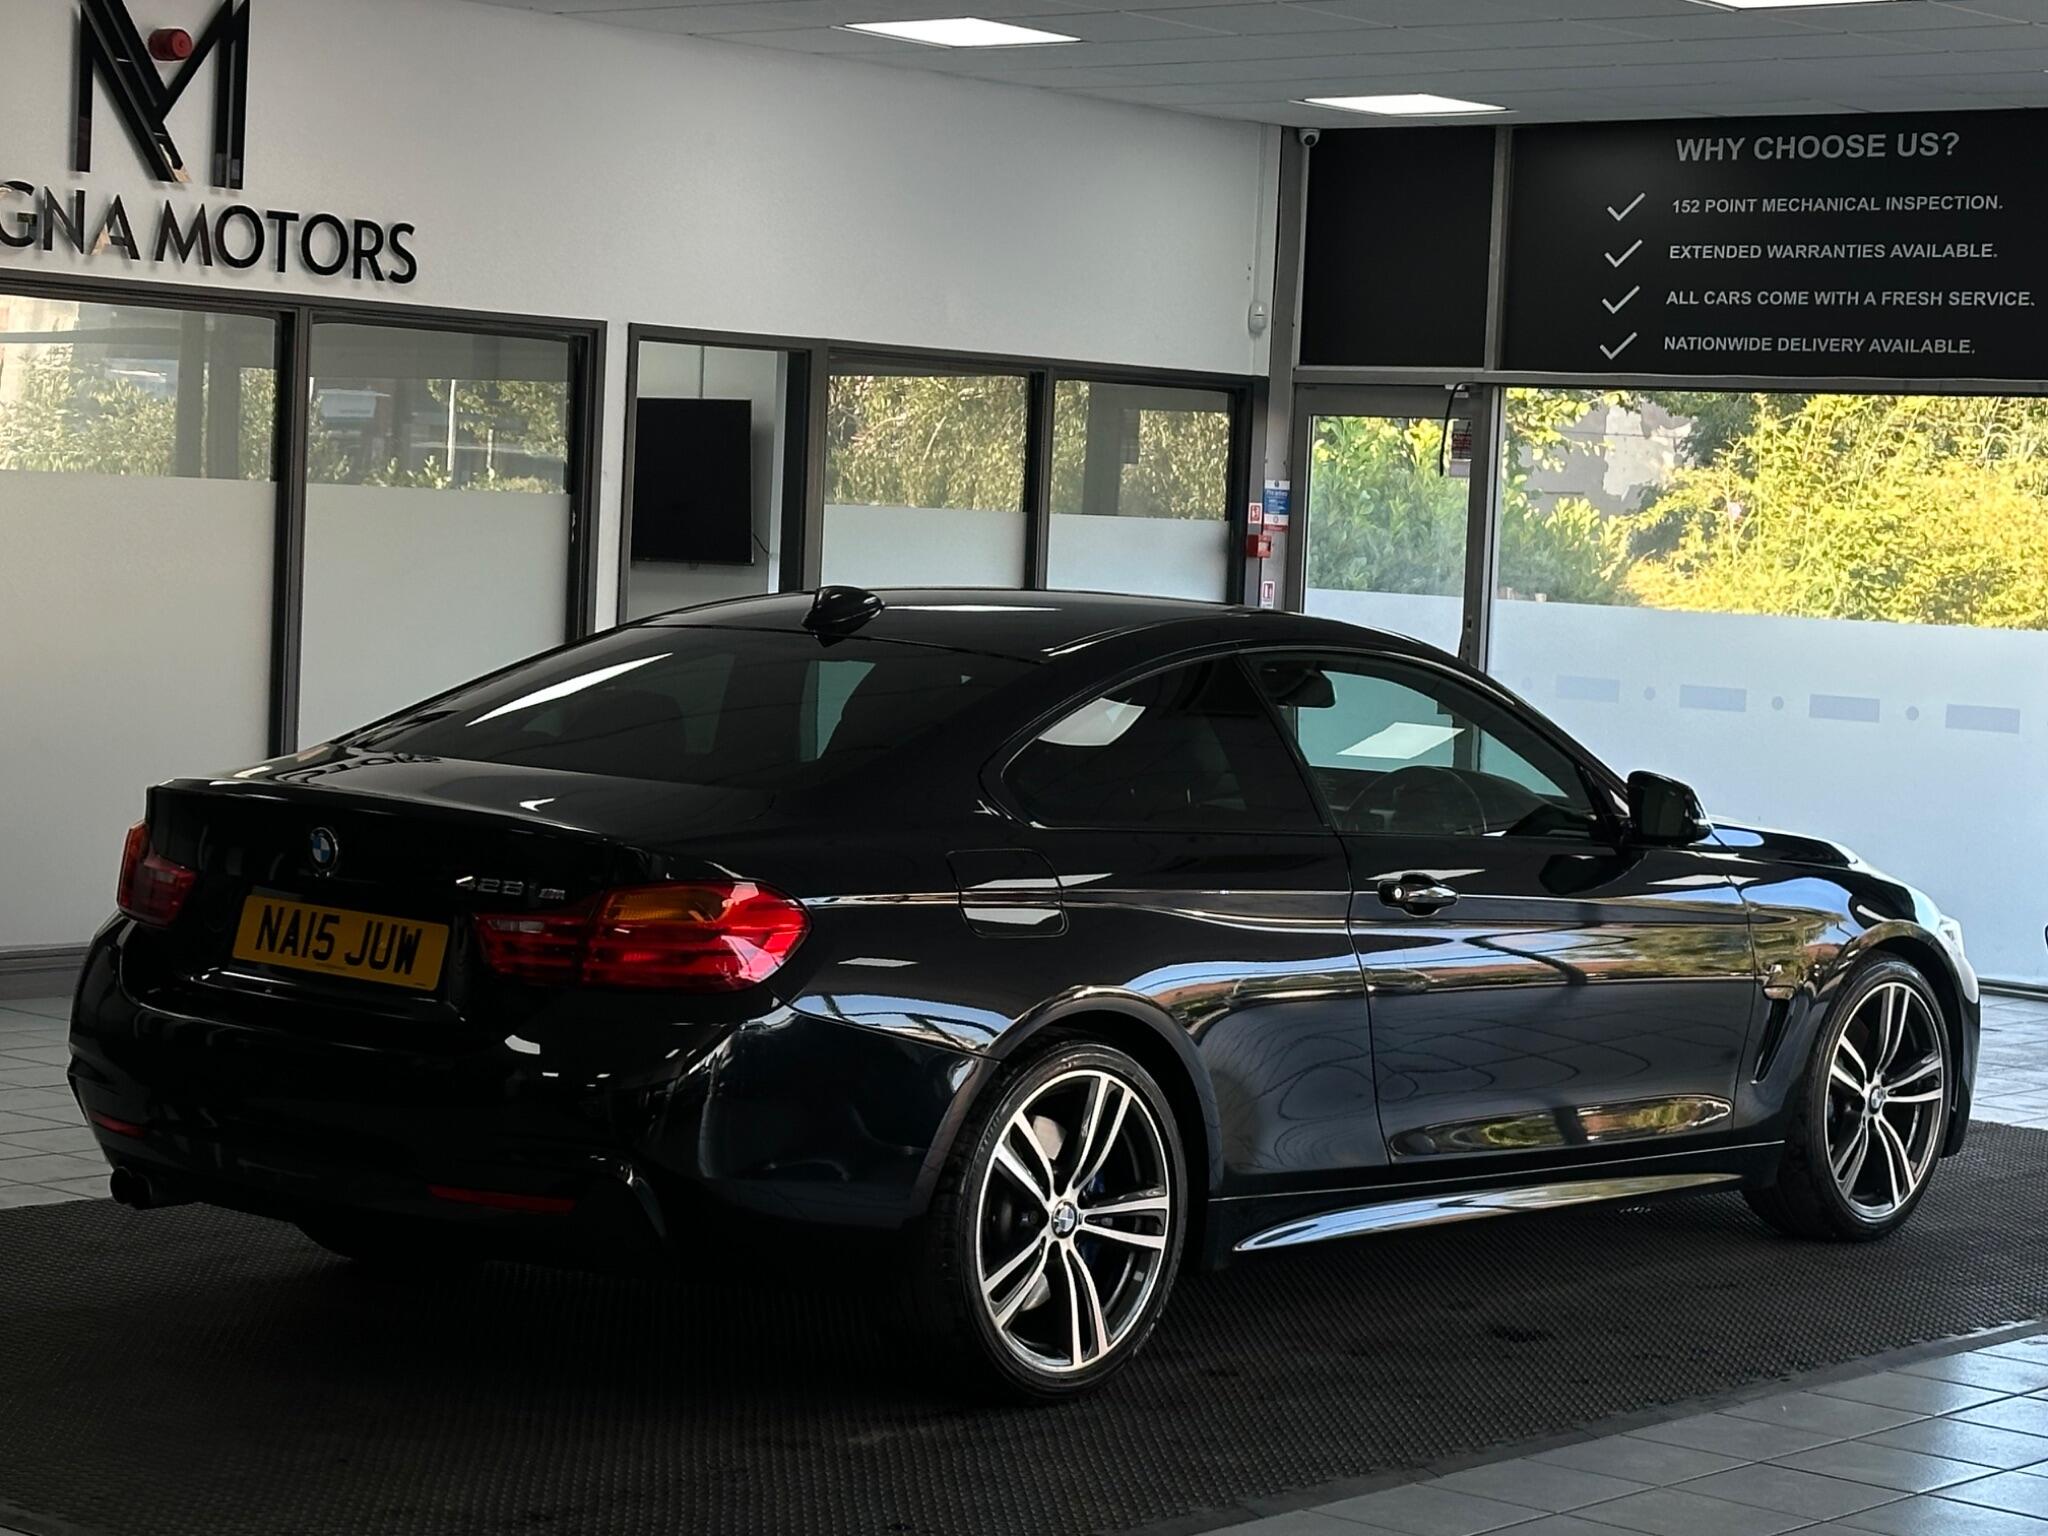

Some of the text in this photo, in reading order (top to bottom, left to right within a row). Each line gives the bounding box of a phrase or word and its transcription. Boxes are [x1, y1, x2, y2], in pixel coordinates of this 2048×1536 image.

[1676, 132, 1960, 162] WHY CHOOSE US?
[1672, 195, 2003, 214] 152 POINT MECHANICAL INSPECTION.
[154, 199, 418, 284] MOTORS
[1669, 243, 1998, 259] EXTENDED WARRANTIES AVAILABLE.
[1665, 290, 2036, 307] ALL CARS COME WITH A FRESH SERVICE.
[1664, 335, 1975, 354] NATIONWIDE DELIVERY AVAILABLE.
[255, 904, 423, 976] NA15 JUW
